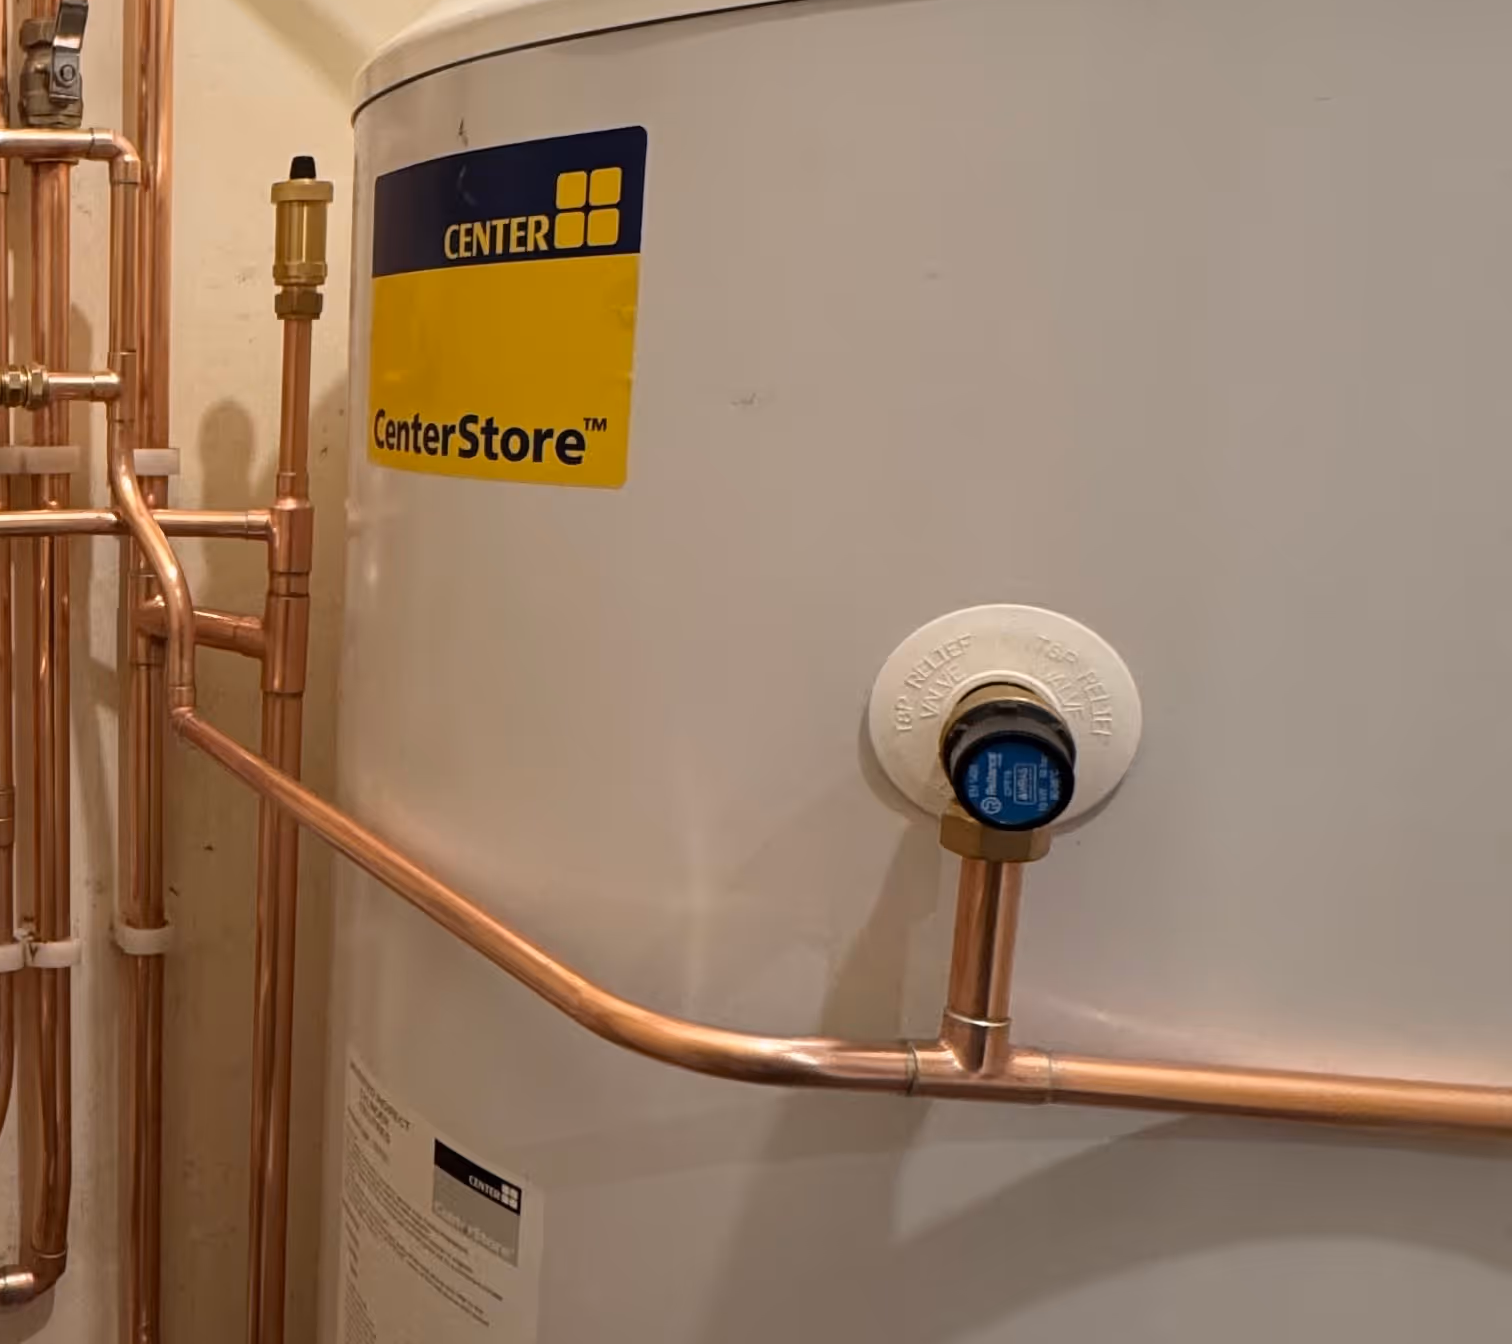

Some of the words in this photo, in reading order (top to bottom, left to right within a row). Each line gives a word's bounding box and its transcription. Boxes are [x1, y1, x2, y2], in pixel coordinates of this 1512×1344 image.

[444, 213, 549, 261] CENTER
[920, 663, 967, 722] VALVE
[468, 1173, 502, 1204] CENTER
